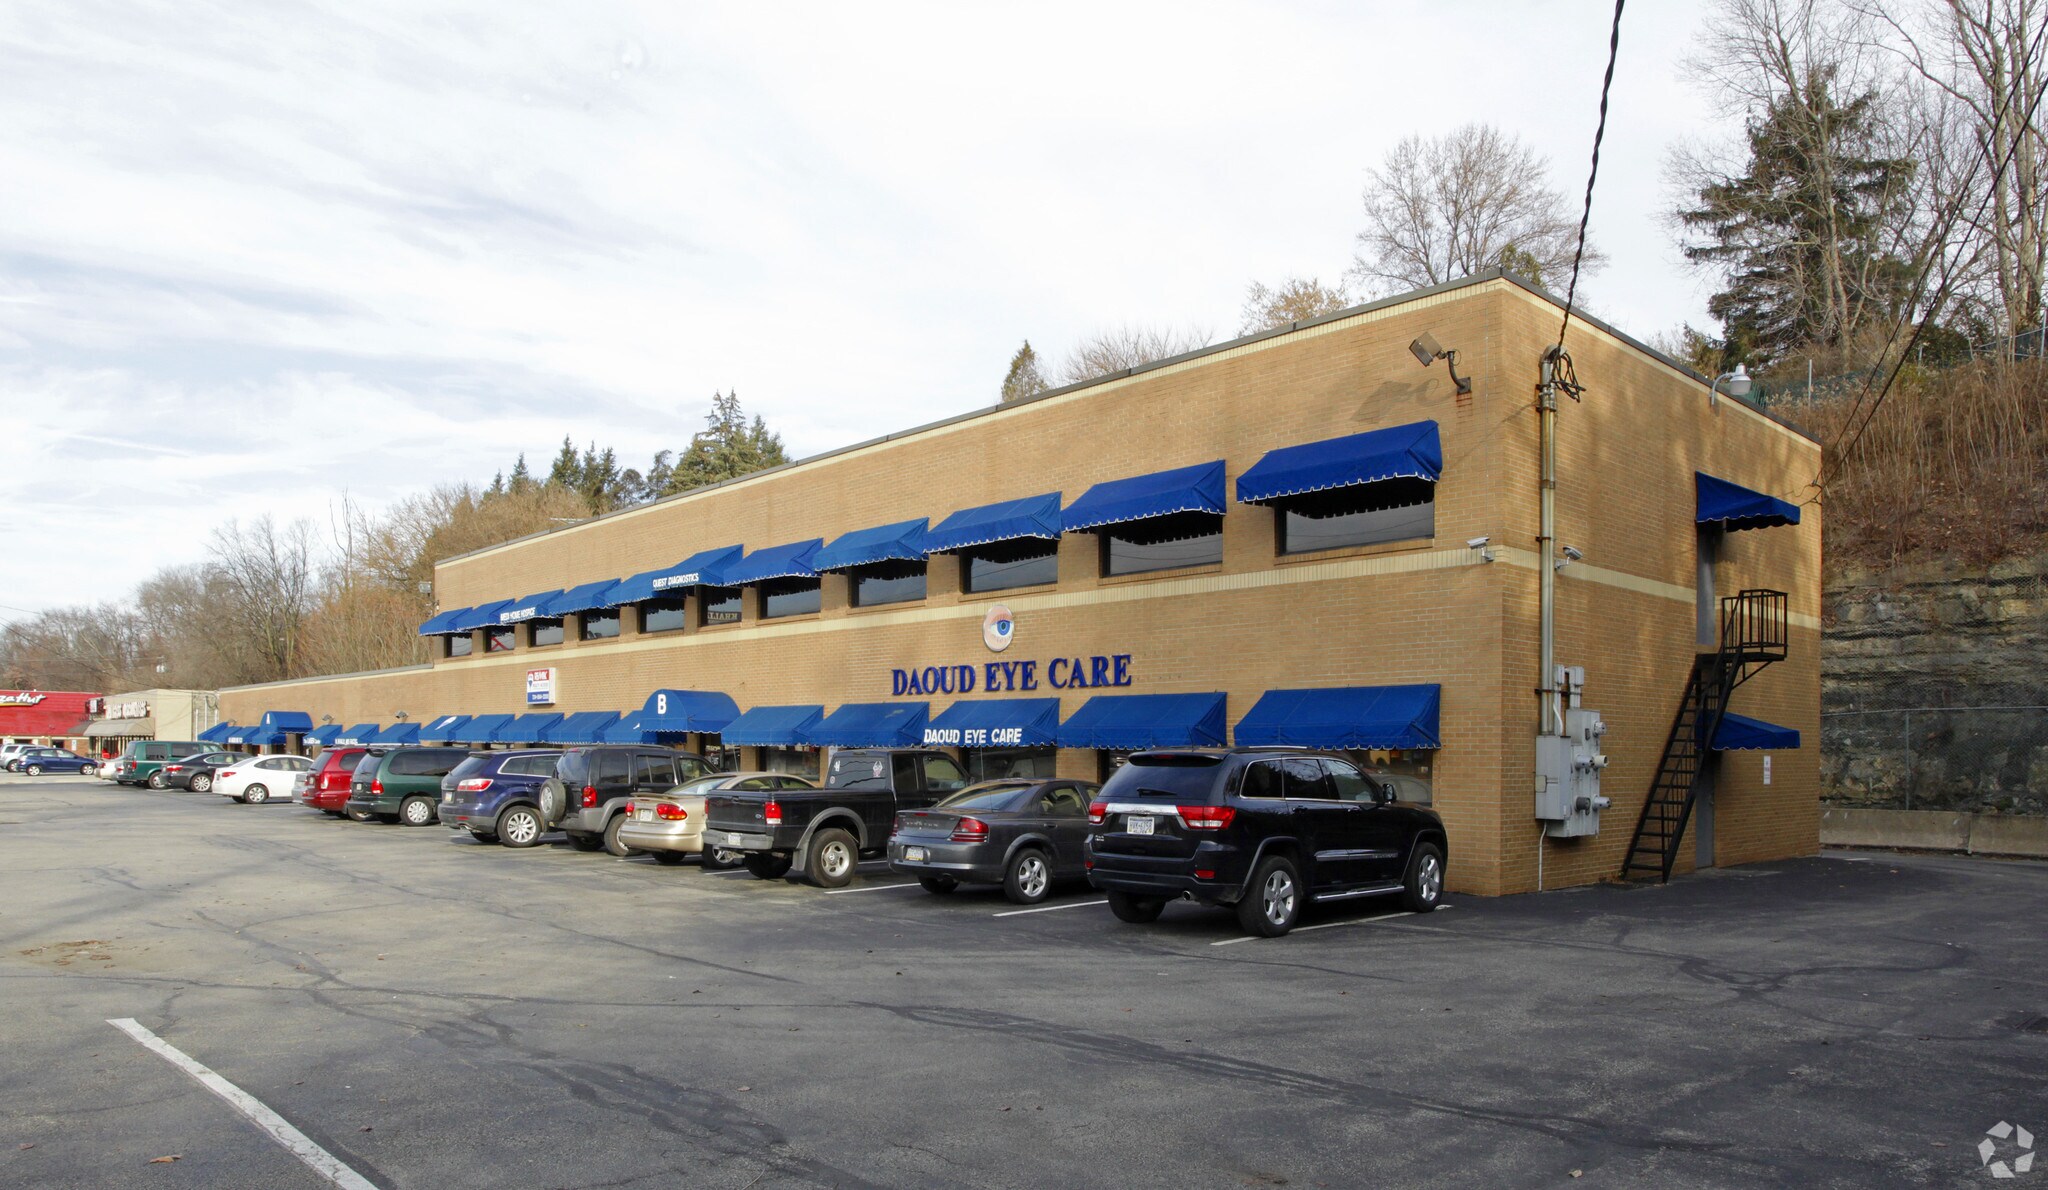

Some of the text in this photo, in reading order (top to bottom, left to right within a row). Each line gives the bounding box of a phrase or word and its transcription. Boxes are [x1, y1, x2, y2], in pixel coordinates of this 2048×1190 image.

[652, 572, 699, 588] QUEST DIAGNOSTICS
[892, 653, 1133, 696] DAOUD EYE CARE
[16, 692, 47, 704] Hut
[657, 694, 667, 715] B
[924, 727, 1023, 744] DAOUD EYE CARE
